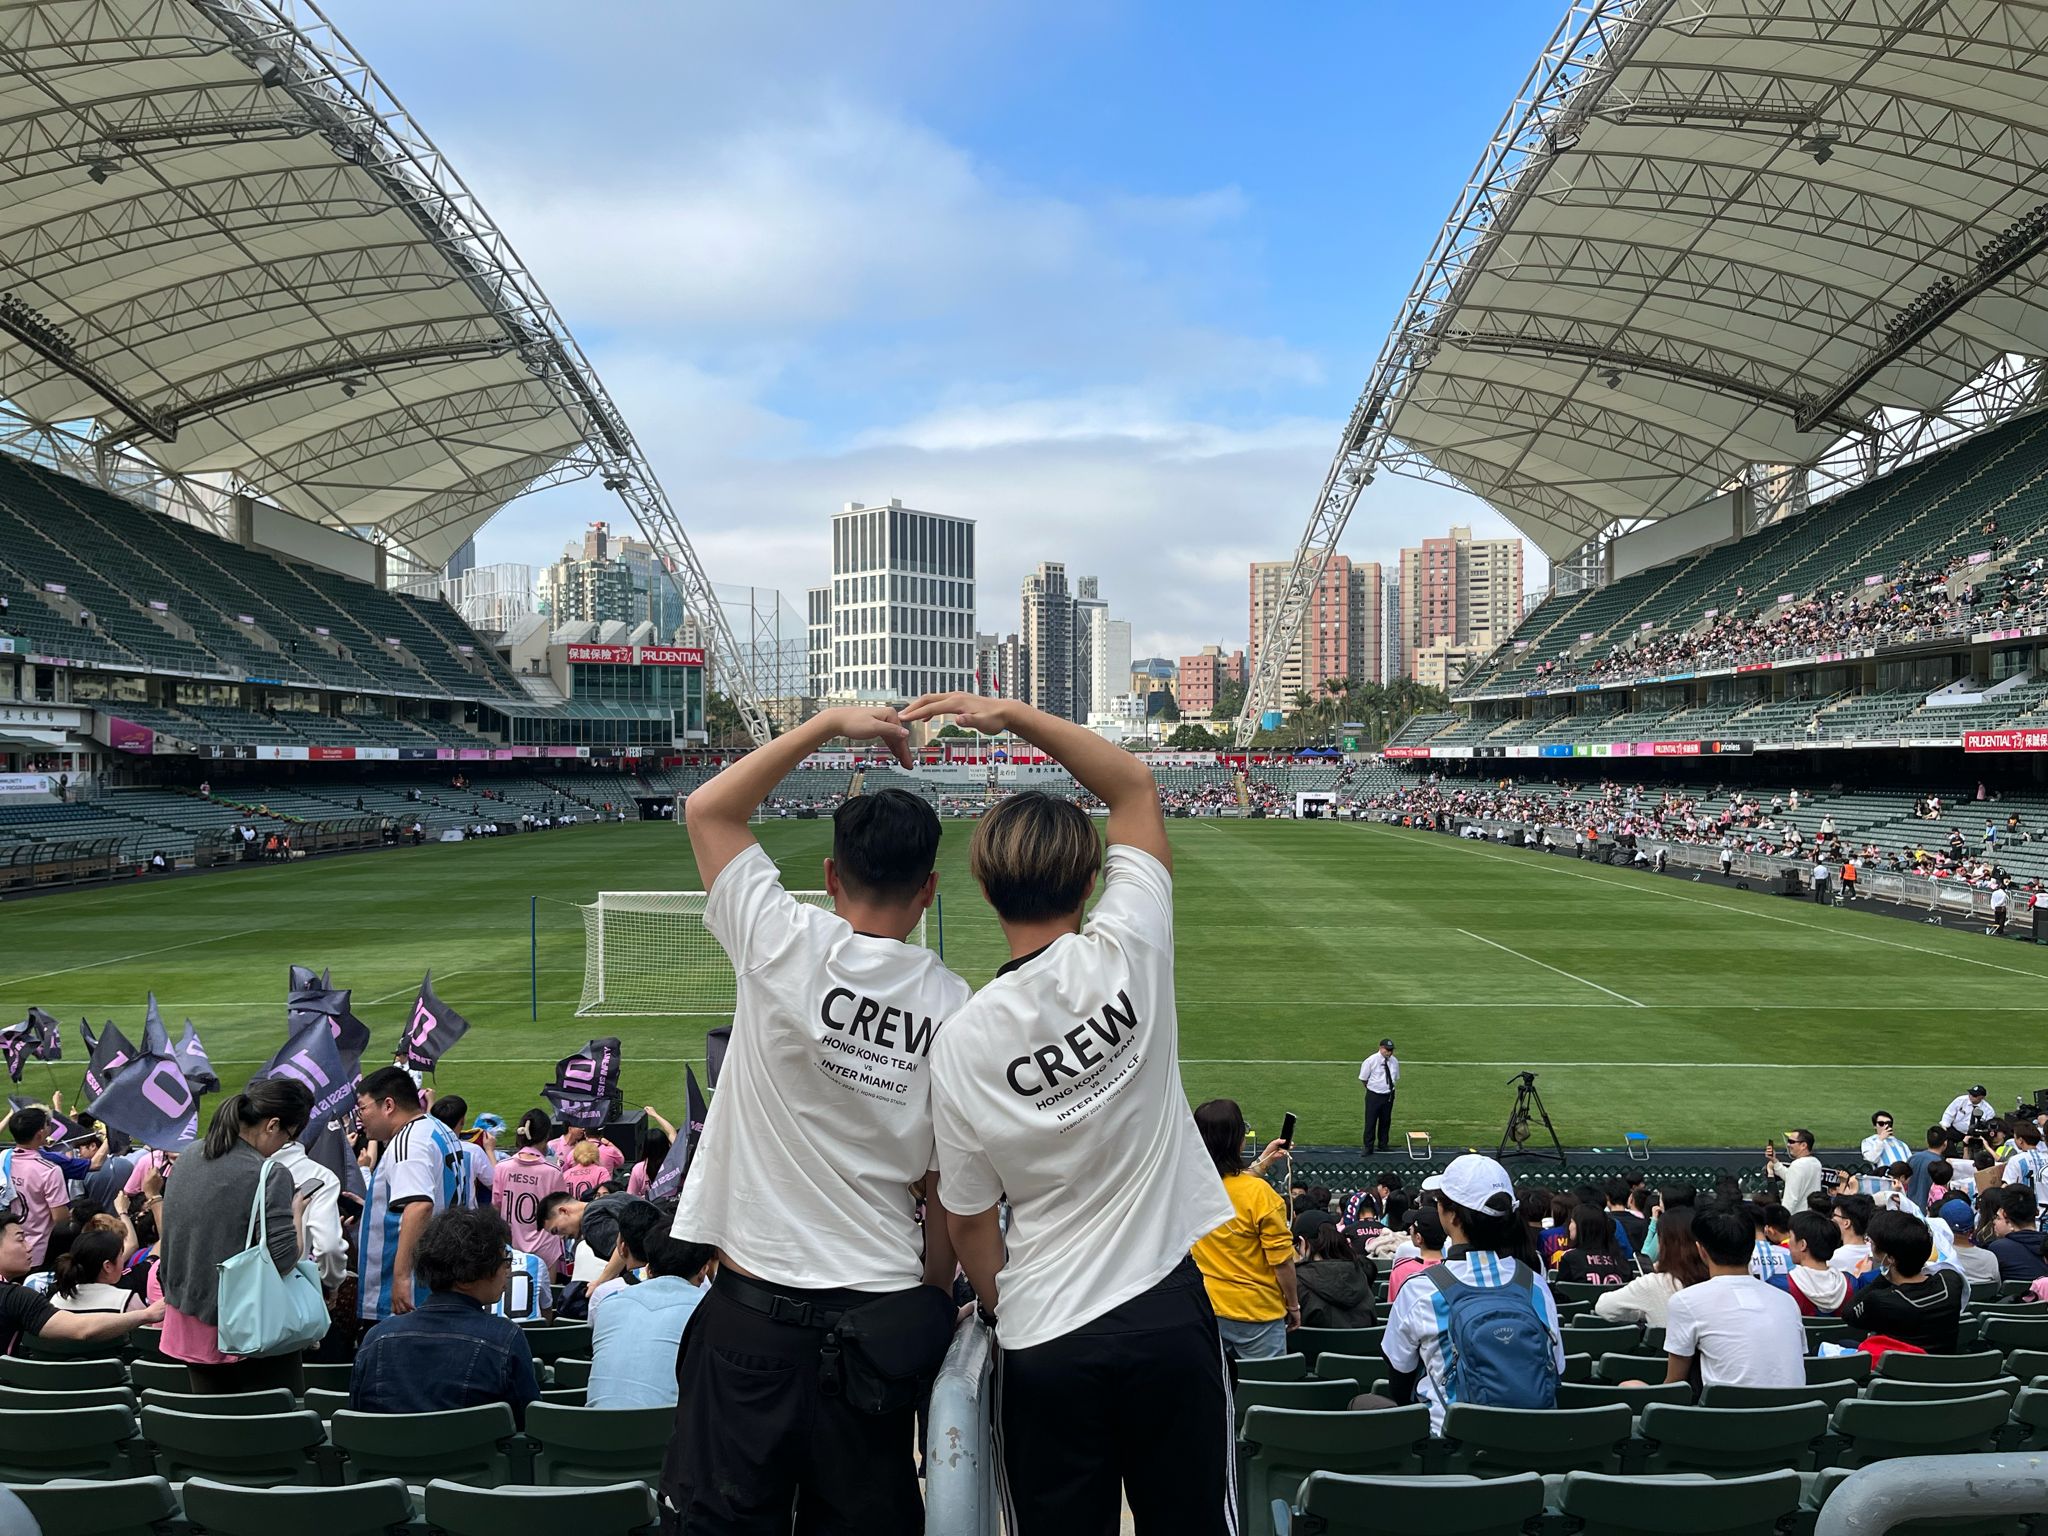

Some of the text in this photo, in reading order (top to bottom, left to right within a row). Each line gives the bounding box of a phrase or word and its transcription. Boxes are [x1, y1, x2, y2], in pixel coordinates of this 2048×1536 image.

[568, 647, 612, 660] 保誠保險
[641, 651, 703, 663] PRUDENTIAL
[1720, 743, 1741, 753] priceless
[1968, 735, 2012, 748] PRUDENTIAL
[821, 987, 943, 1058] CREW
[1006, 988, 1138, 1097] CREW
[822, 1035, 856, 1055] HONG
[856, 1047, 888, 1065] KONG
[821, 1059, 858, 1081] INTER
[859, 1073, 895, 1091] MIAMI
[1036, 1087, 1073, 1111] HONG
[1074, 1063, 1107, 1090] KONG
[1107, 1034, 1136, 1064] TEAM
[1057, 1096, 1093, 1121] INTER
[1094, 1069, 1128, 1098] MIAMI
[1127, 1052, 1140, 1069] CF
[1090, 1080, 1100, 1089] VS
[861, 1090, 876, 1098] HONG
[876, 1095, 889, 1103] KONG
[1063, 1113, 1090, 1132] FEBRUARY
[1106, 1090, 1121, 1102] HONG
[570, 1168, 592, 1177] MESSI
[508, 1173, 539, 1186] MESSI
[503, 1190, 541, 1224] 10
[1752, 1256, 1783, 1266] MESSI
